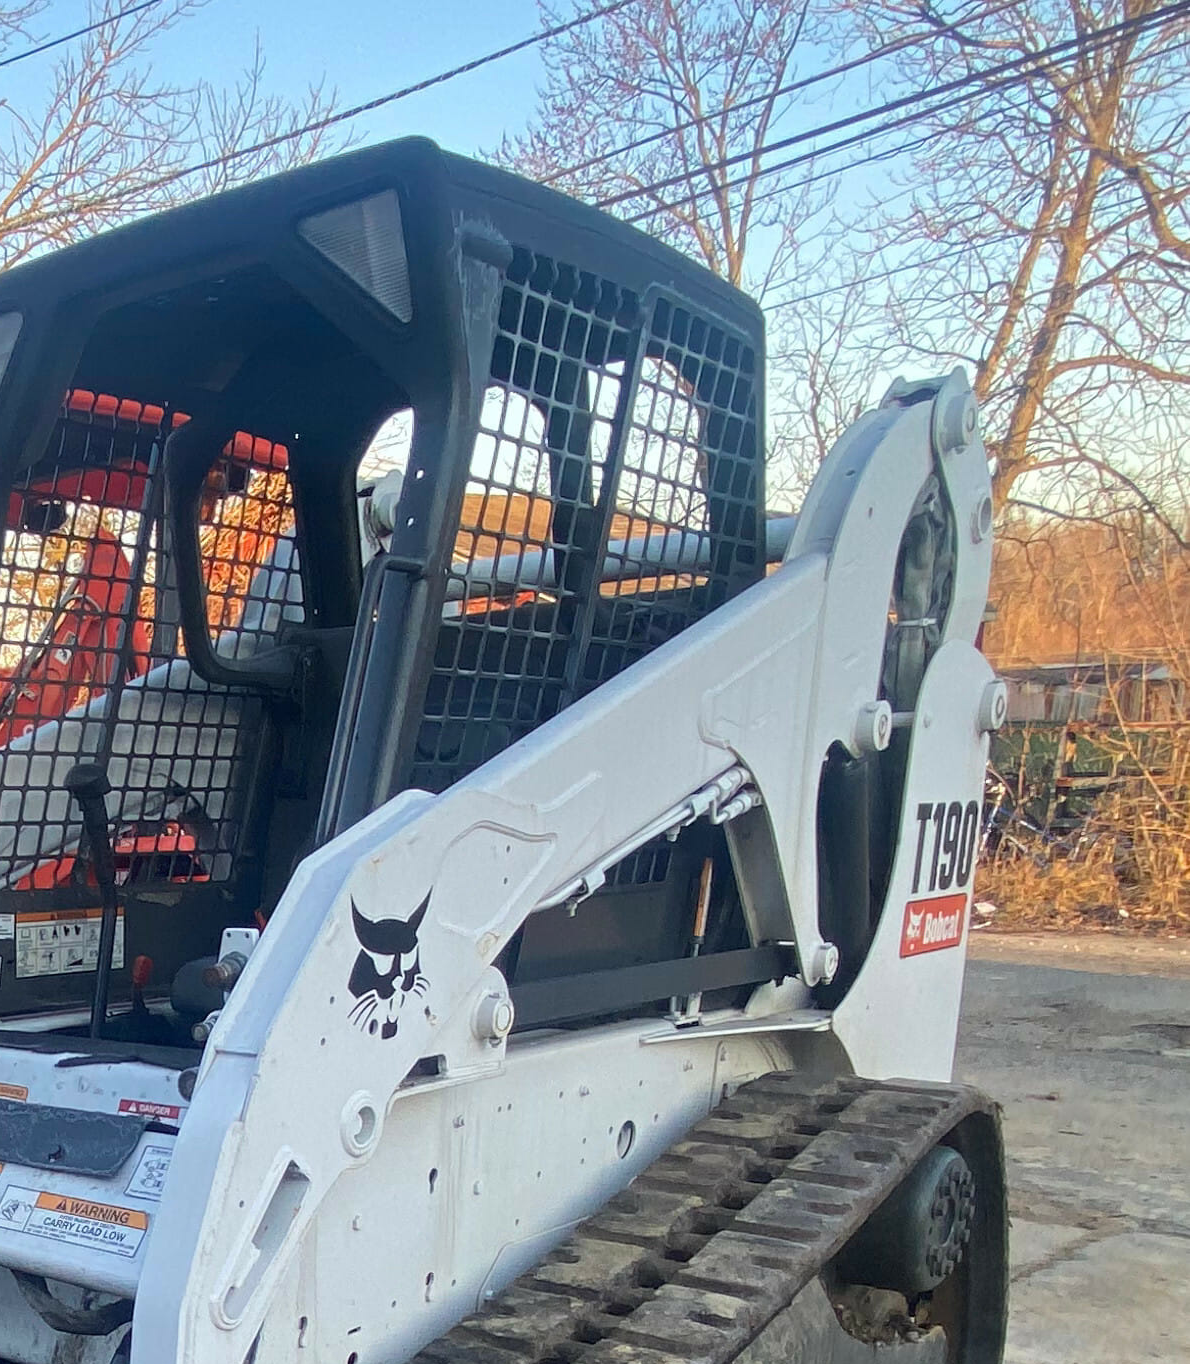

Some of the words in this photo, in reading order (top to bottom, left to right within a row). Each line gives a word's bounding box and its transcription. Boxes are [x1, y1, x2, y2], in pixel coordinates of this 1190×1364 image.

[911, 800, 979, 894] T190
[923, 909, 960, 944] Bobcat
[139, 1104, 171, 1116] DANGER
[69, 1200, 130, 1224] WARNING
[43, 1216, 75, 1231] CARRY
[75, 1223, 103, 1237] LOAD
[103, 1229, 127, 1242] LOW
